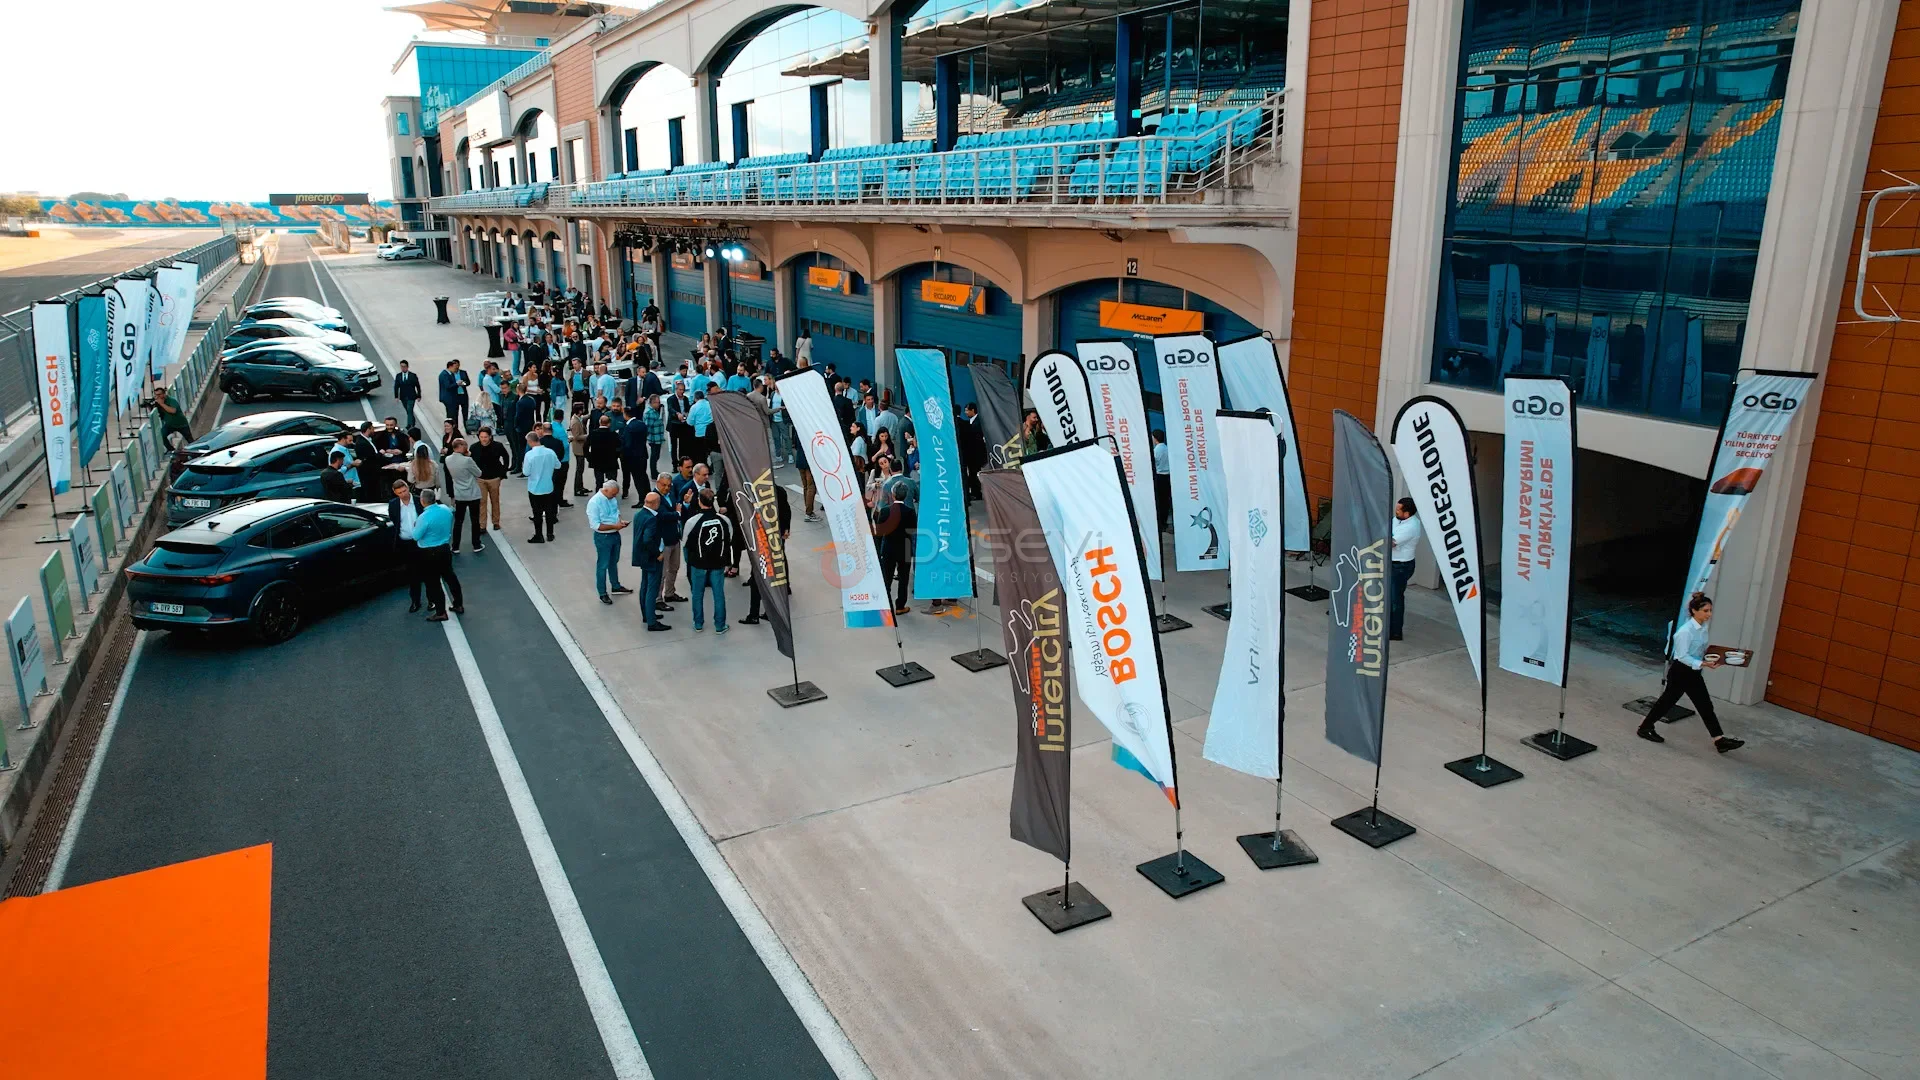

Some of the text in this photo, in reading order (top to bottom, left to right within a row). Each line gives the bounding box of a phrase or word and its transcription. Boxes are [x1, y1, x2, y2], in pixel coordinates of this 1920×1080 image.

[1127, 261, 1137, 273] 12
[1131, 313, 1163, 323] McLaren
[46, 356, 63, 426] BOSCH
[1724, 440, 1778, 450] YILIN OTOMO
[1735, 450, 1773, 459] SEÇİLİYO
